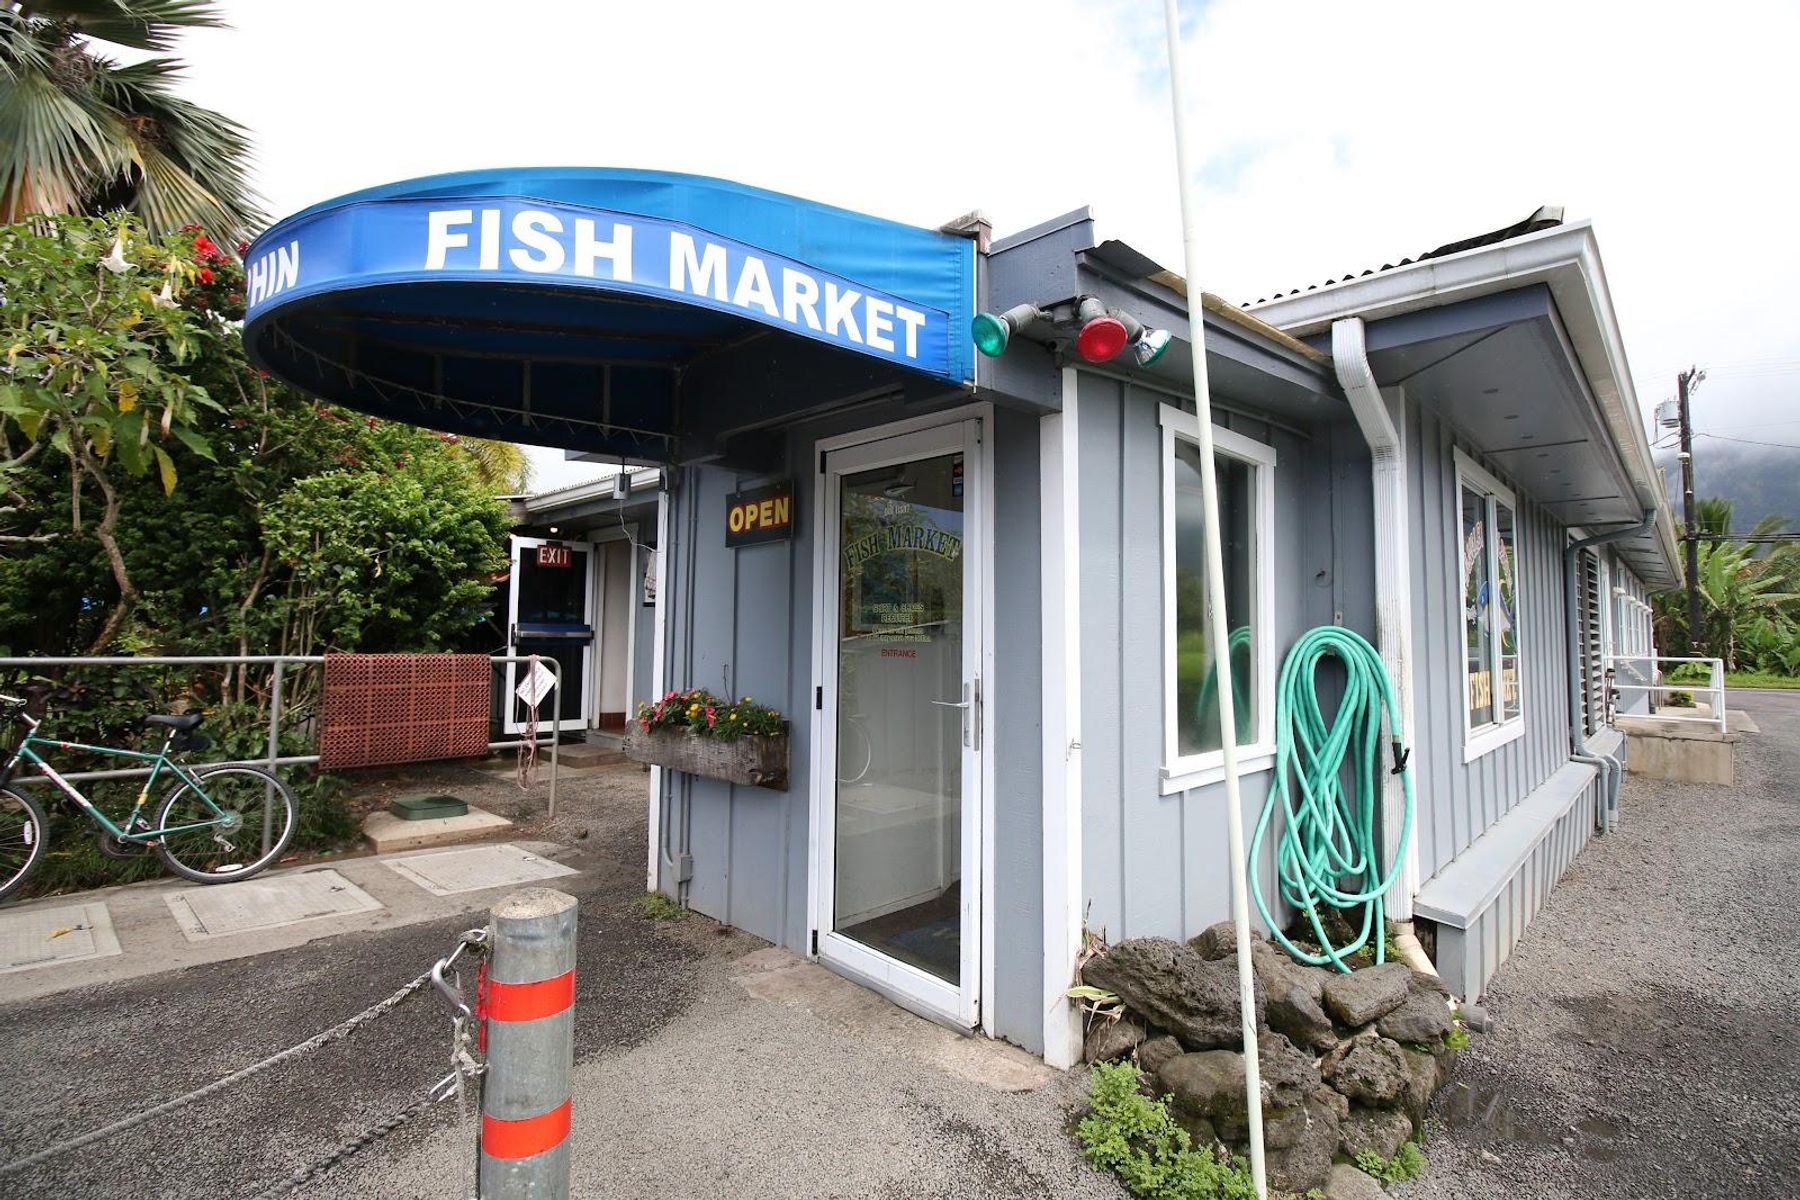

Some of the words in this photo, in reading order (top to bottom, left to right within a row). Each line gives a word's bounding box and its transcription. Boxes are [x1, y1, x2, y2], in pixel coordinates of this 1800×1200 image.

[246, 239, 299, 308] HIN
[423, 209, 633, 282] FISH
[669, 231, 926, 359] MARKET
[729, 496, 790, 532] OPEN
[539, 547, 569, 565] EXIT
[843, 532, 880, 569] FISH
[887, 524, 960, 562] MARKET
[881, 649, 917, 658] ENTRANCE
[1469, 671, 1491, 710] FISH
